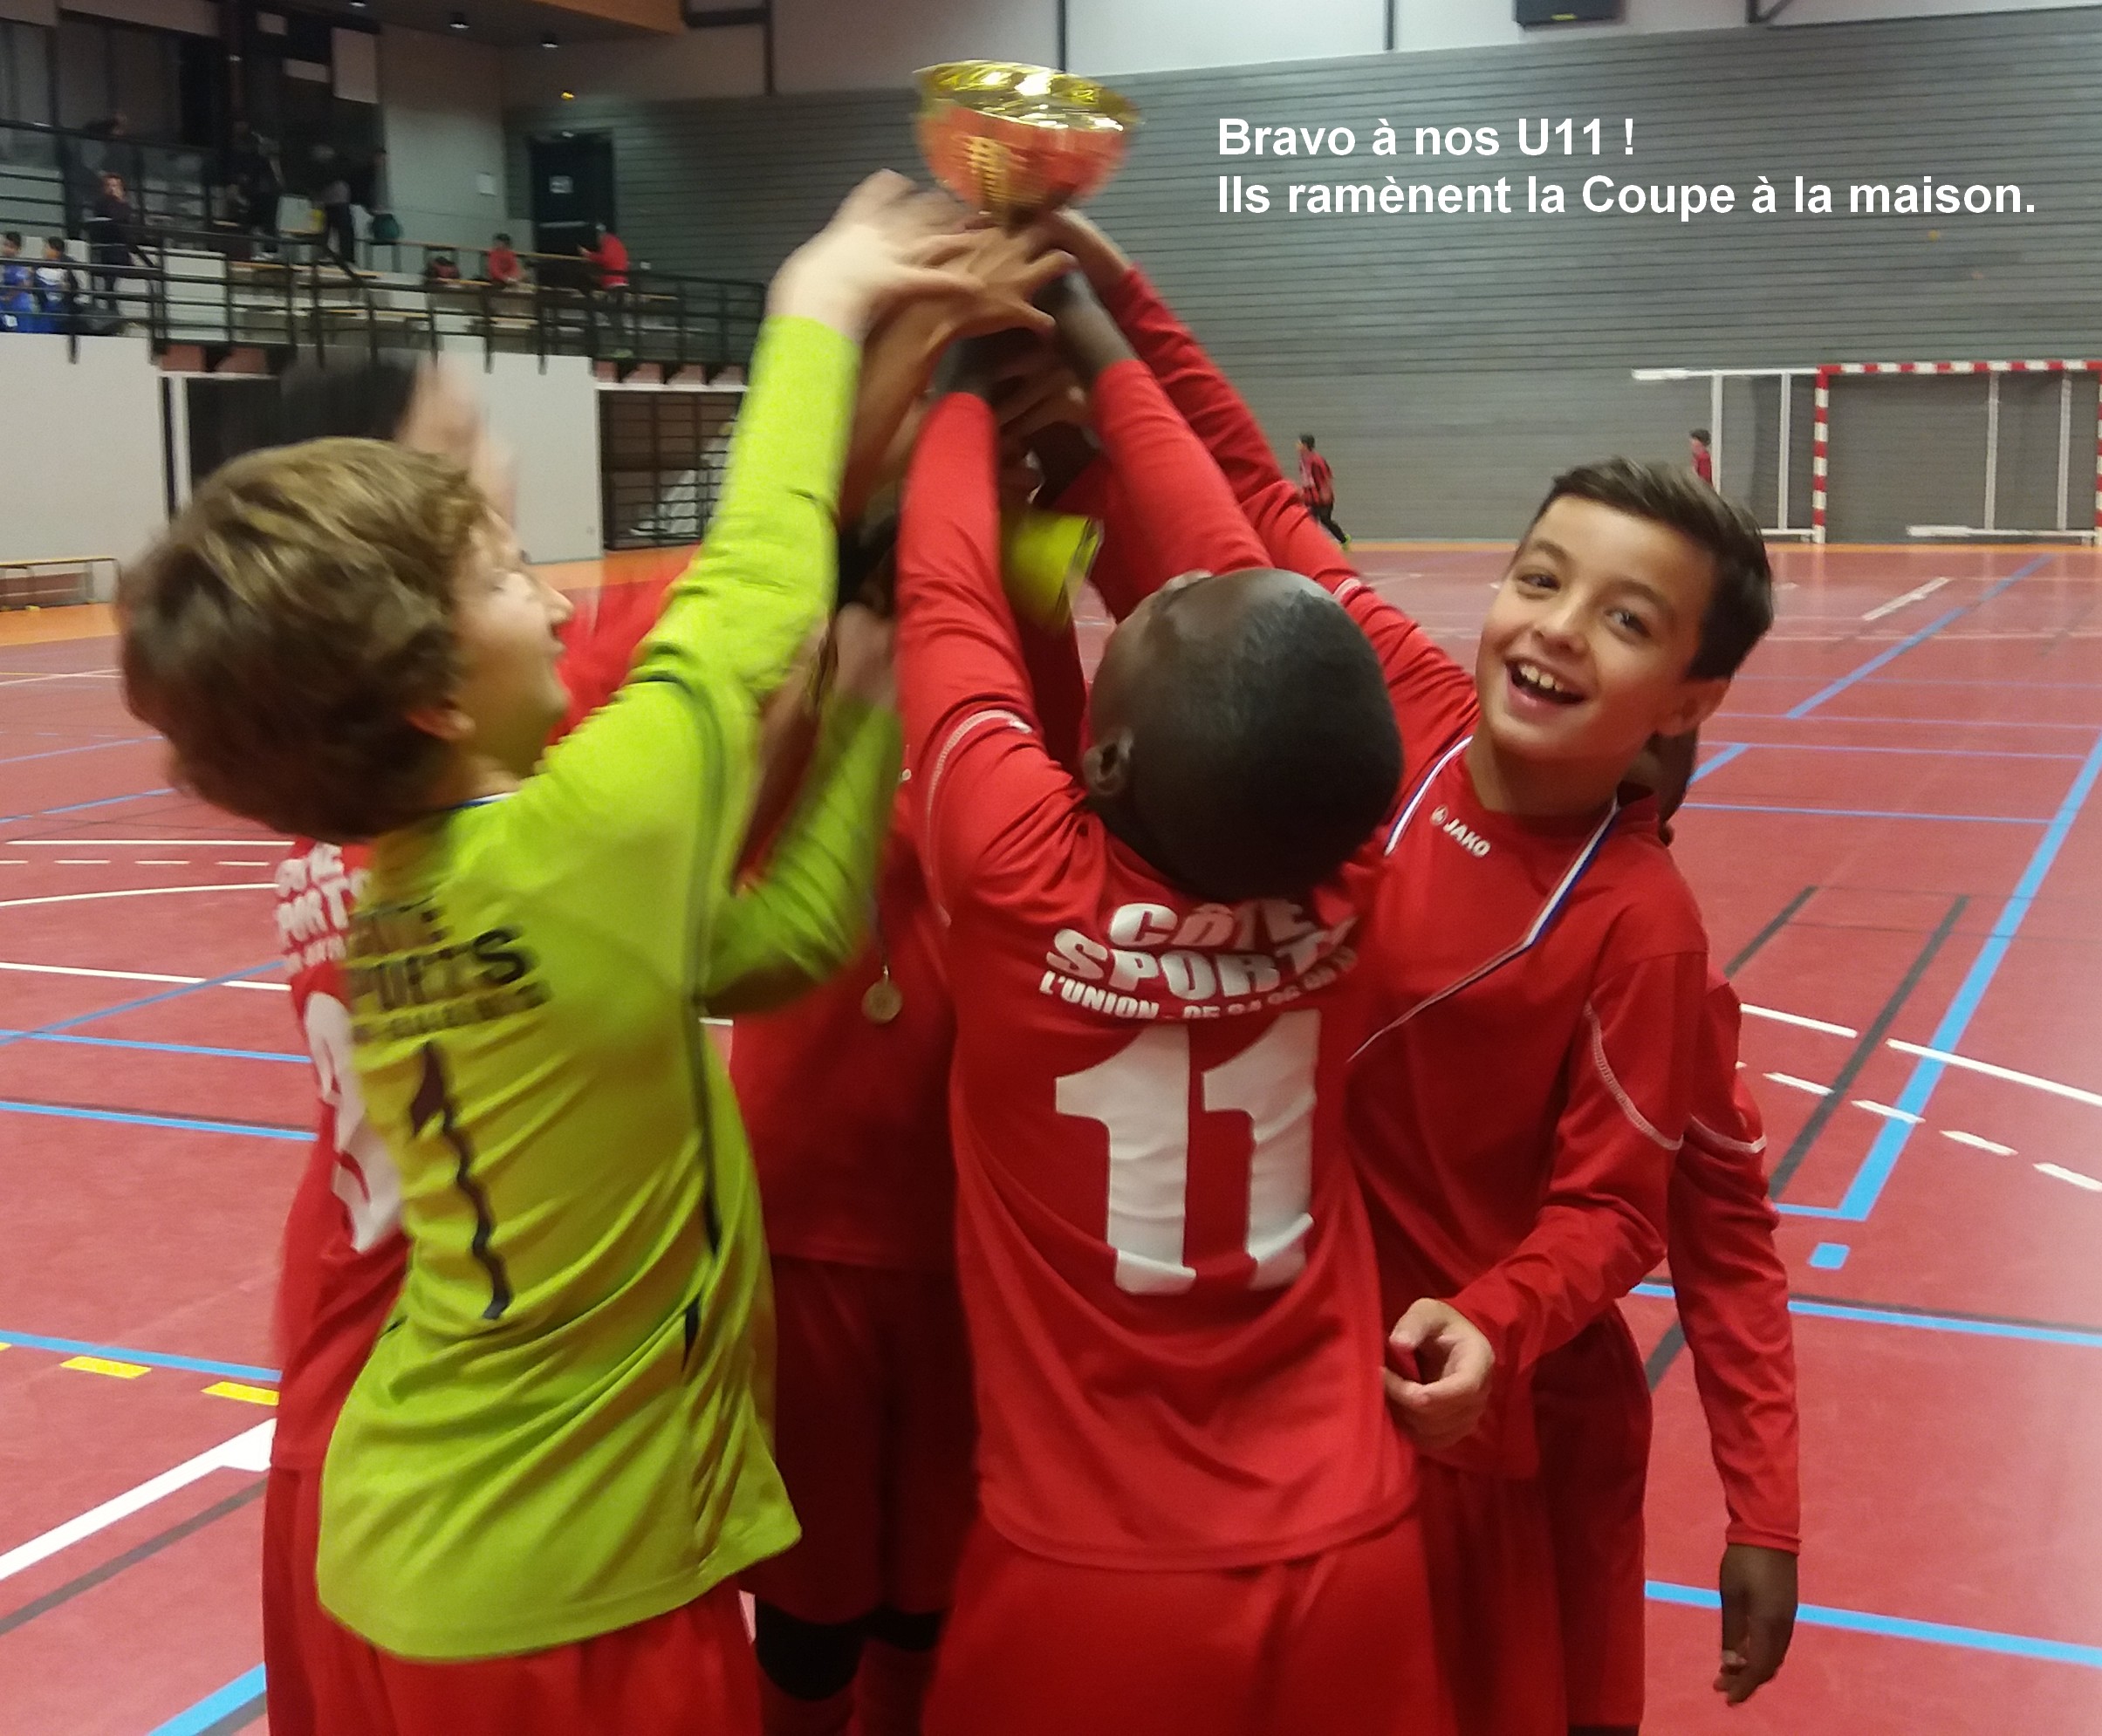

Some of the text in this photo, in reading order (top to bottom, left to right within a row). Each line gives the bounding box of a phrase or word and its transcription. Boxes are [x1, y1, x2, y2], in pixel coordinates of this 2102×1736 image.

[1442, 817, 1491, 858] JAKO
[1038, 970, 1160, 1020] L'UNION
[1055, 1008, 1322, 1295] 11
